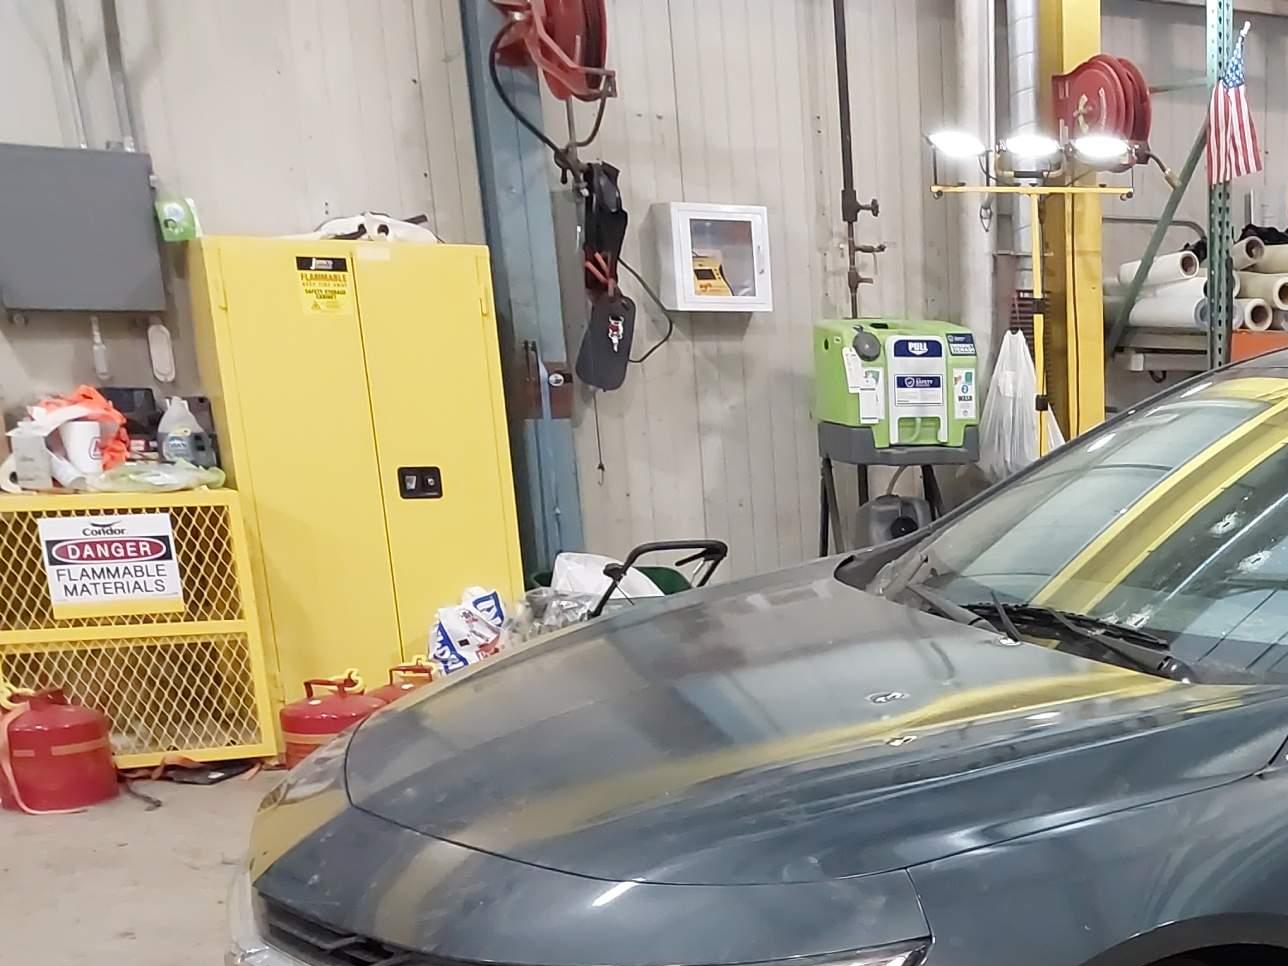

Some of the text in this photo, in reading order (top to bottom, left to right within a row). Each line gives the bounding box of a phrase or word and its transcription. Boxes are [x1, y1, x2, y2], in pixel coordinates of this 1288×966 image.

[908, 342, 928, 351] PULL
[82, 527, 126, 537] Condor
[67, 541, 152, 559] DANGER
[56, 563, 168, 582] FLAMMABLE
[63, 579, 166, 597] MATERIALS
